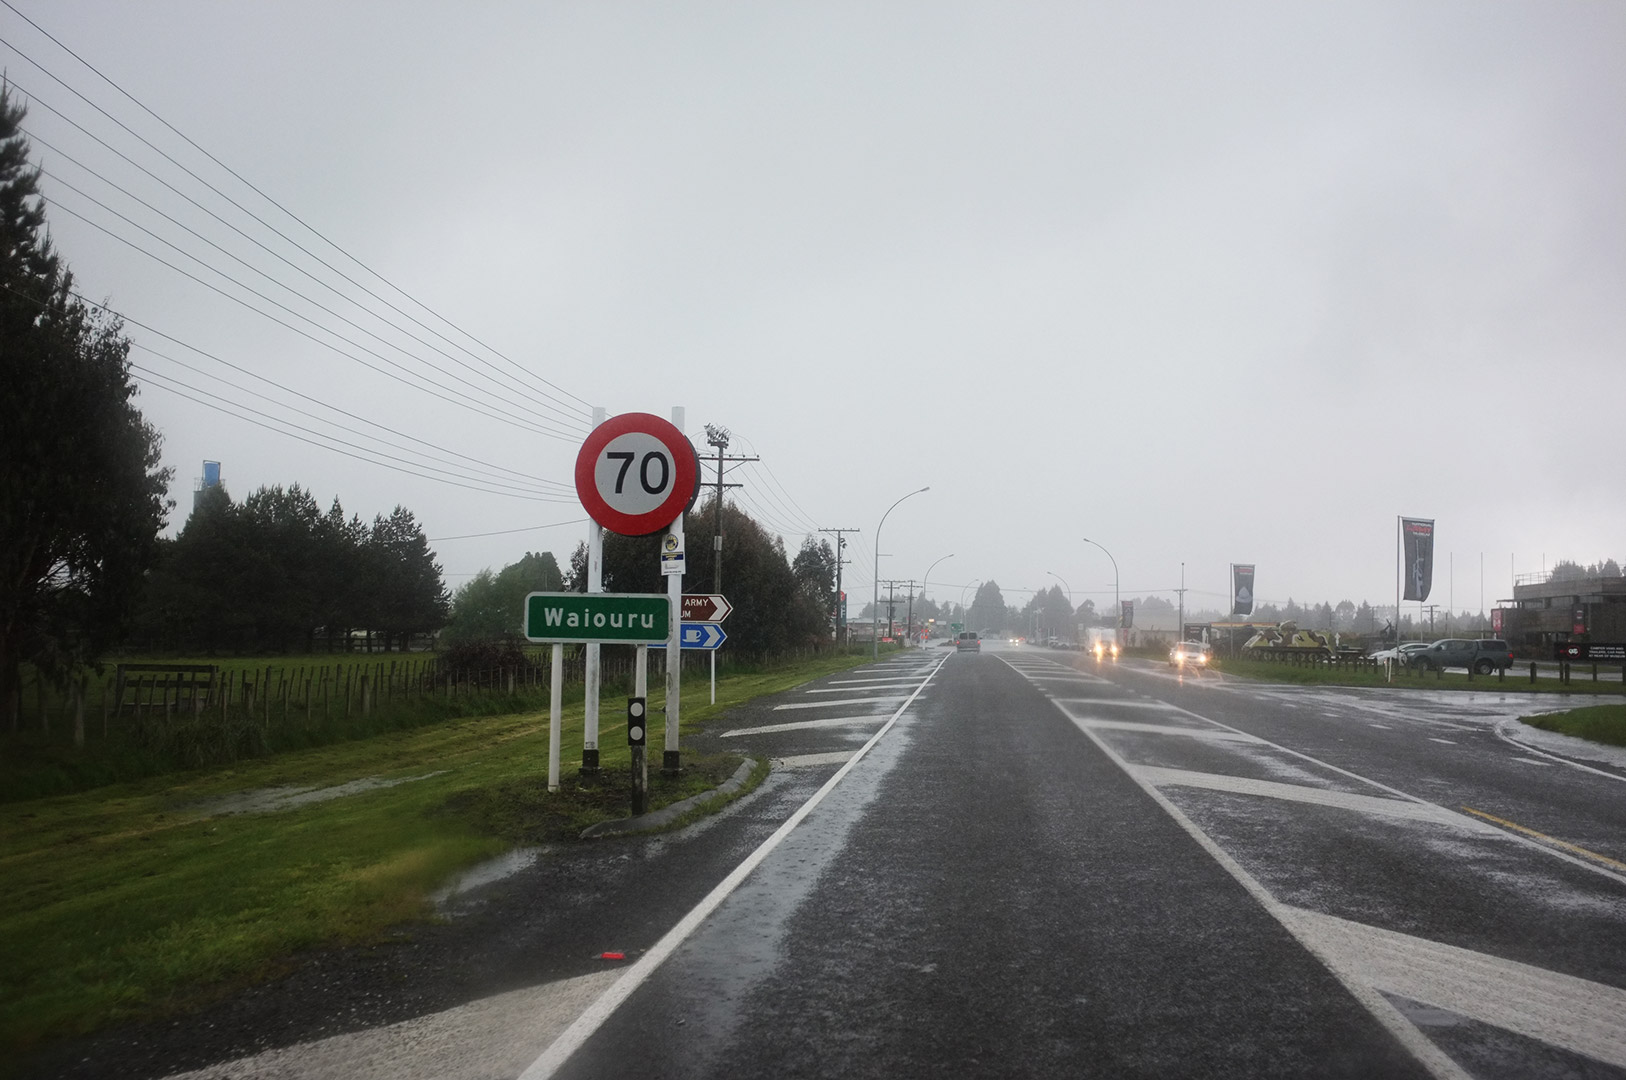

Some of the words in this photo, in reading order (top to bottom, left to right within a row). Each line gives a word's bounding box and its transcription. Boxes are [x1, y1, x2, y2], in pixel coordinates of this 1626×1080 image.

[606, 451, 669, 494] 70
[684, 598, 709, 607] ARMY
[544, 607, 654, 629] Waiouru
